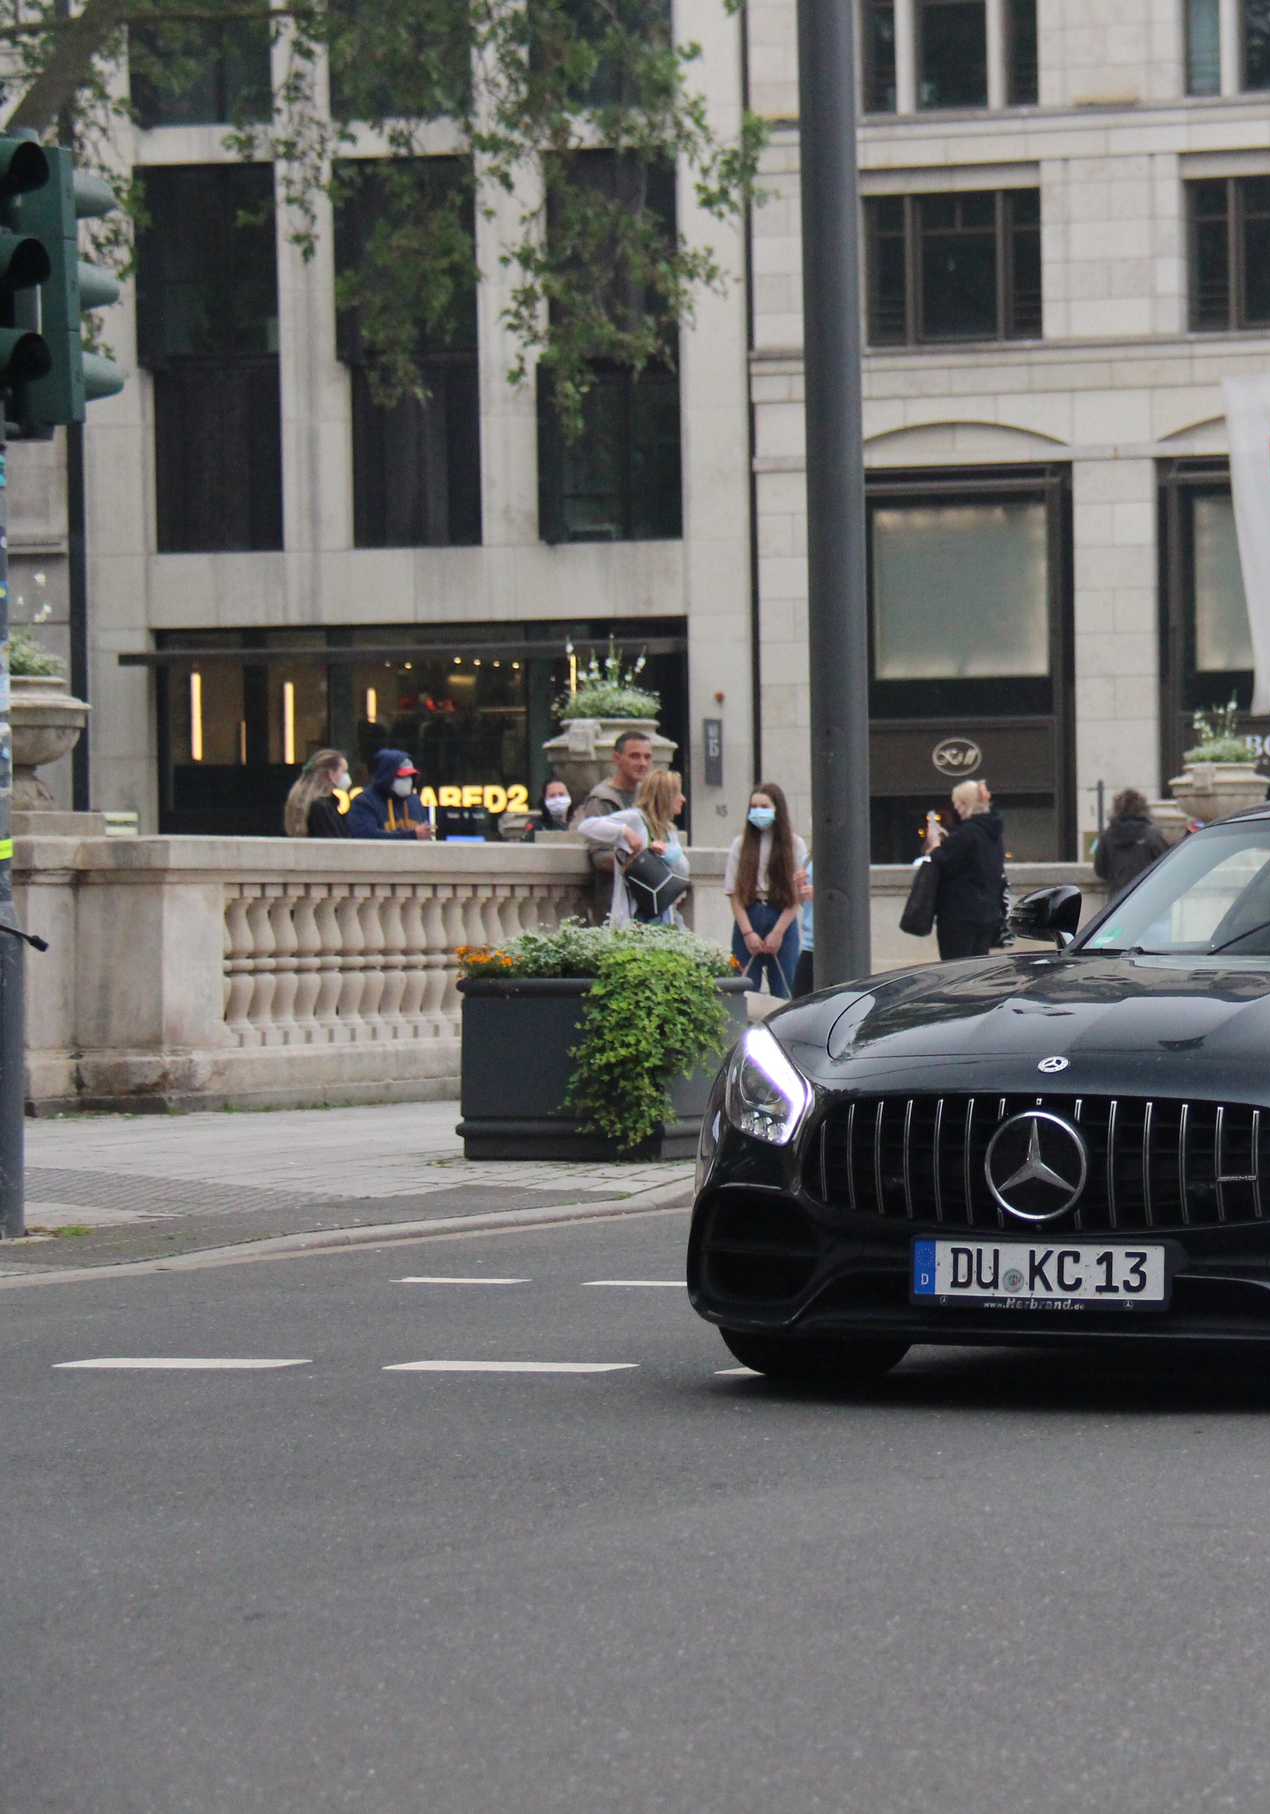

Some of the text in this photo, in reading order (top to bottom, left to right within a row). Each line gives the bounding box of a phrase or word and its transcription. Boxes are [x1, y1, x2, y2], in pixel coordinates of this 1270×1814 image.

[920, 1273, 929, 1285] D
[950, 1247, 1148, 1293] DU KC 13
